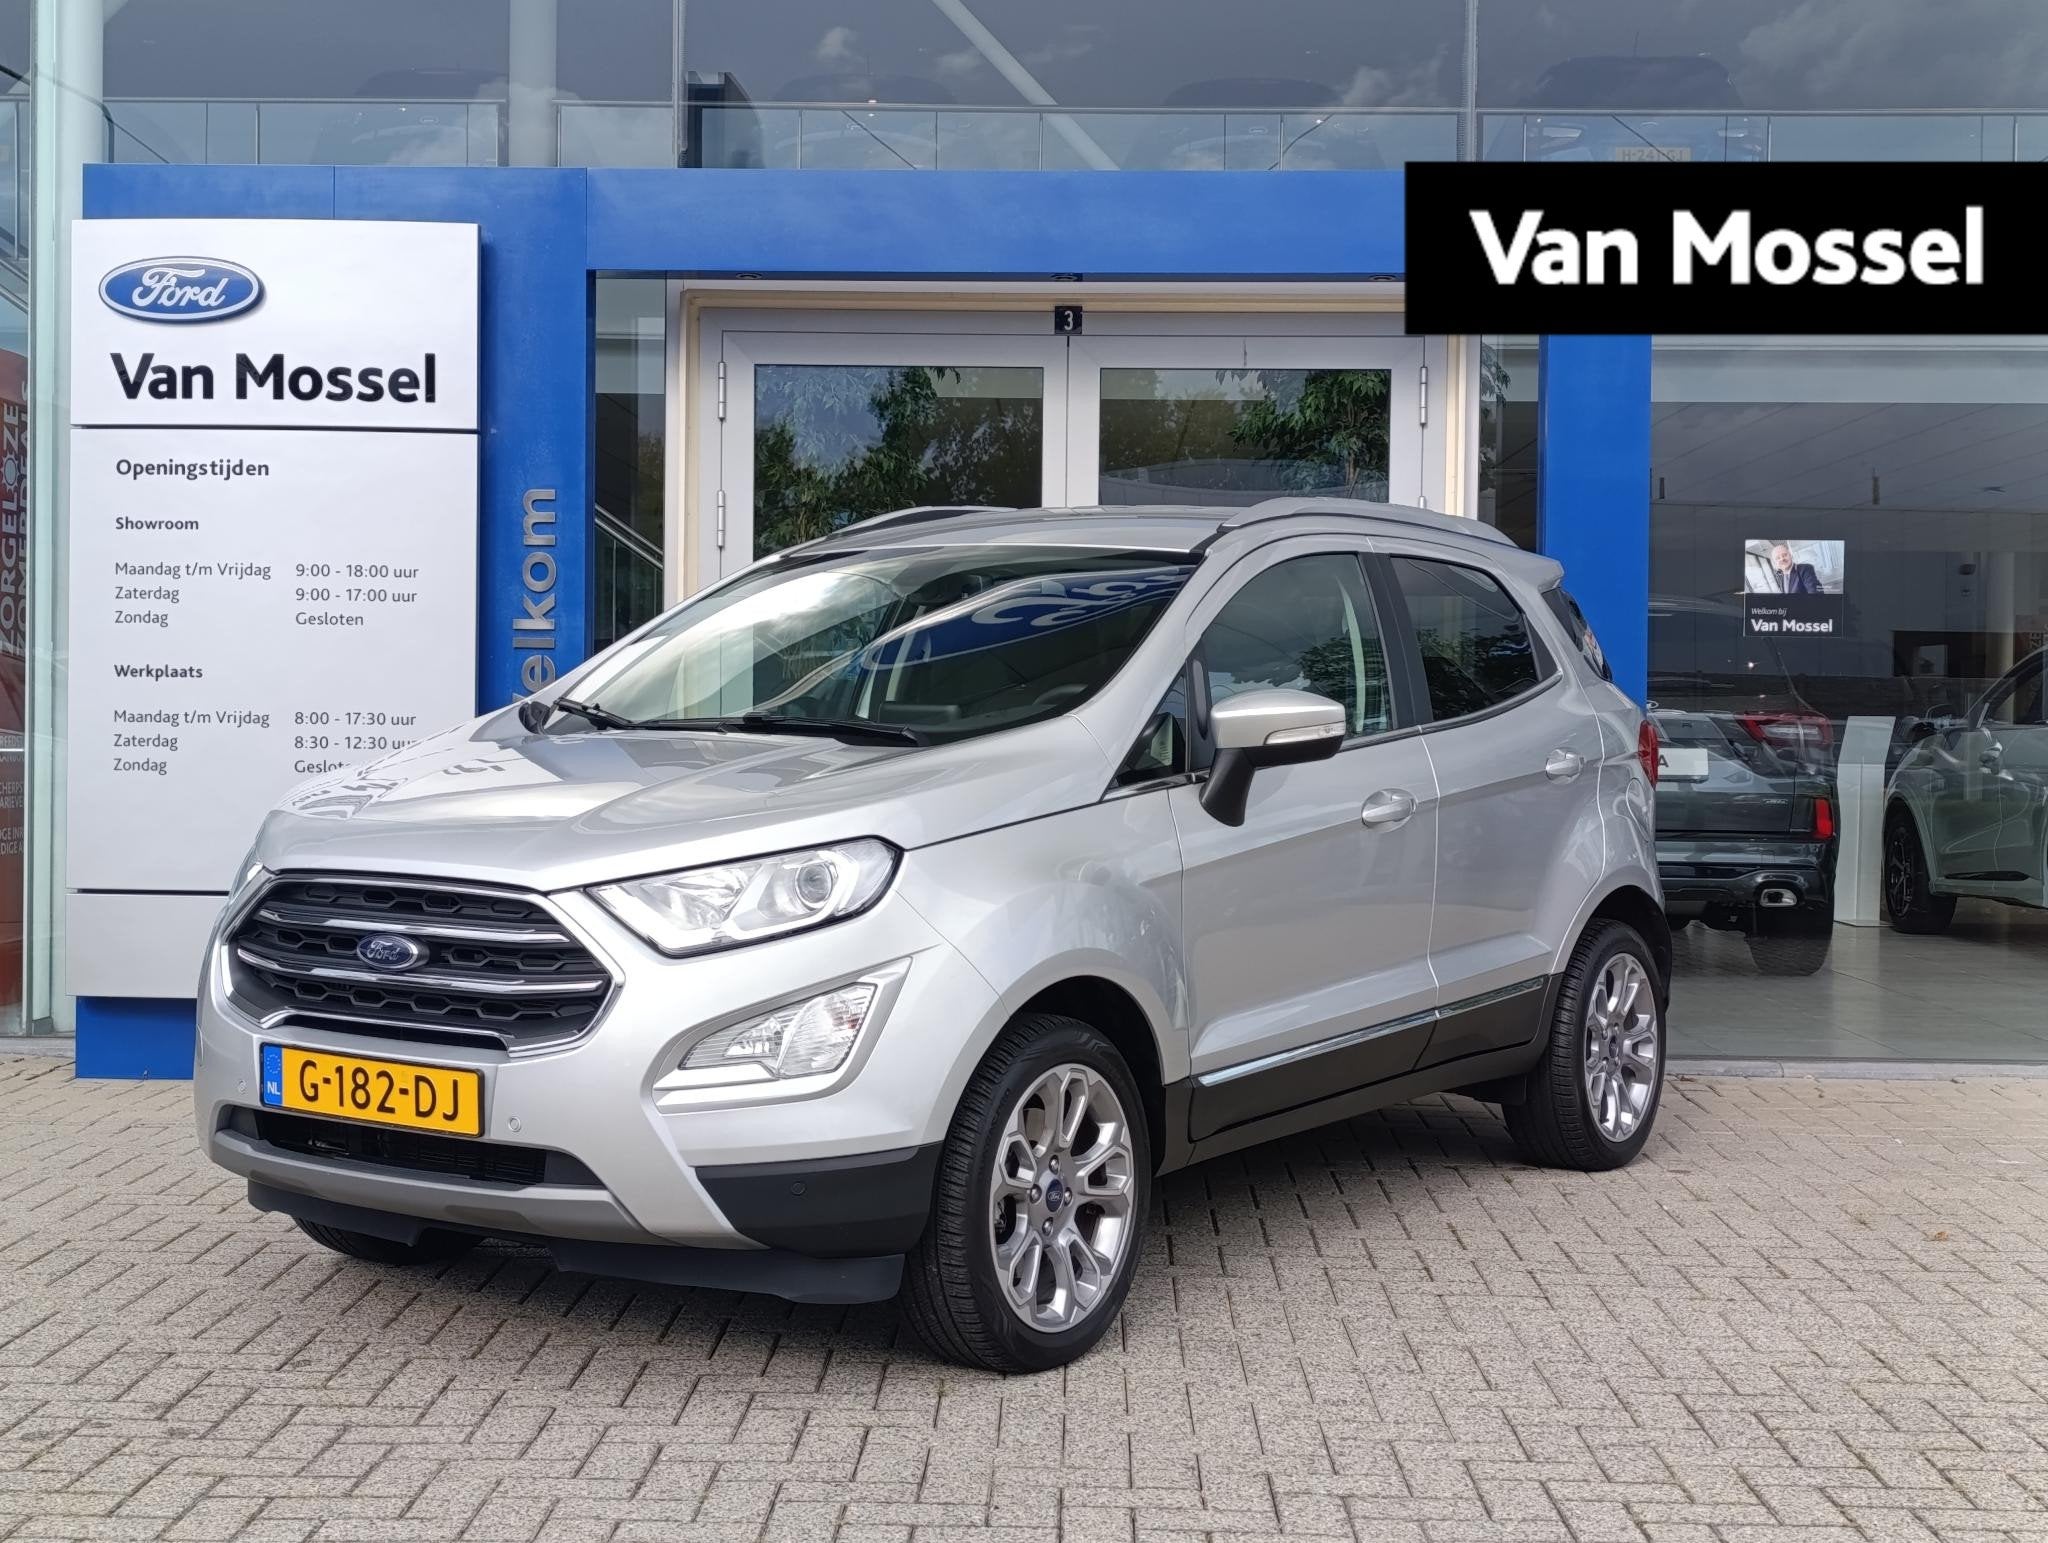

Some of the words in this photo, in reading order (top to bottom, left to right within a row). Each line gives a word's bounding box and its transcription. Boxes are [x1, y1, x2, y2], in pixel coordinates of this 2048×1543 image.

[132, 267, 226, 307] Ford
[1064, 310, 1074, 331] 3
[110, 352, 214, 400] Van
[235, 352, 436, 403] Mossel
[115, 458, 270, 481] Openingstijden
[115, 515, 199, 531] Showroom
[115, 561, 181, 580] Maandag
[185, 561, 213, 577] t/m
[217, 562, 272, 581] Vrijdag
[295, 563, 331, 578] 9:00
[346, 564, 389, 578] 18:00
[393, 568, 419, 579] uur
[115, 585, 180, 604] Zaterdag
[295, 587, 331, 602] 9:00
[345, 588, 388, 603] 17:00
[391, 592, 417, 603] uur
[512, 488, 557, 702] elkom
[114, 609, 169, 628] Zondag
[295, 611, 364, 627] Gesloten
[1751, 607, 1777, 615] Welkom
[1778, 607, 1788, 617] bij
[1750, 618, 1779, 632] Van
[1782, 618, 1833, 632] Mossel
[114, 663, 203, 682] Werkplaats
[113, 709, 180, 728] Maandag
[184, 709, 211, 724] t/m
[215, 710, 270, 729] Vrijdag
[294, 711, 330, 725] 8:00
[344, 712, 387, 726] 17:30
[391, 716, 417, 726] uur
[113, 733, 178, 752] Zaterdag
[294, 735, 329, 749] 8:30
[344, 736, 388, 750] 12:30
[113, 757, 168, 776] Zondag
[294, 759, 351, 774] Geslot
[367, 940, 401, 960] Ford
[266, 1081, 281, 1096] NL
[299, 1059, 460, 1122] G-182-DJ
